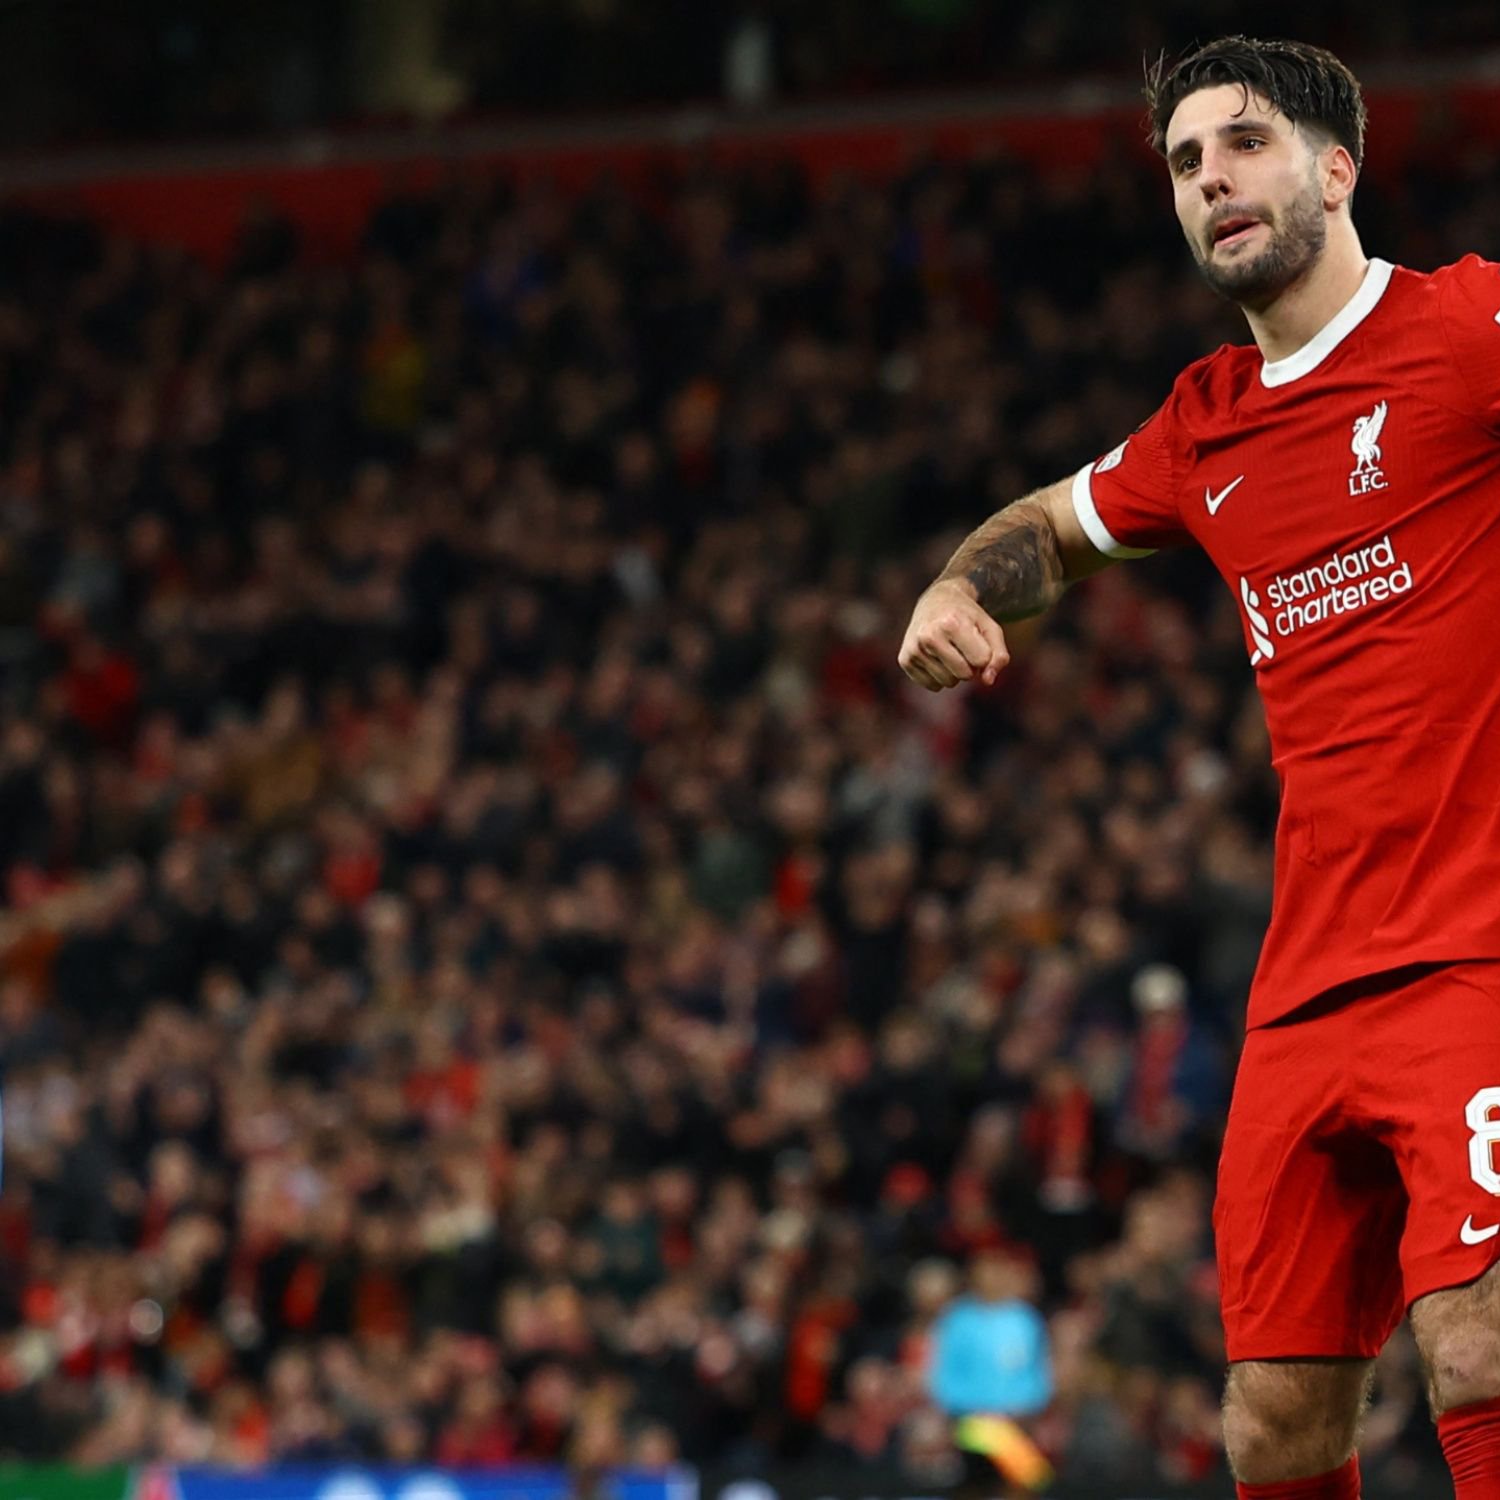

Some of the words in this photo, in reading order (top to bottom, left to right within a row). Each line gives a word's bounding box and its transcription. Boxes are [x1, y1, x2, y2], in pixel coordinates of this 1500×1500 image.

[1349, 471, 1389, 496] L.F.C.
[1267, 535, 1395, 608] standard
[1275, 562, 1413, 636] chartered
